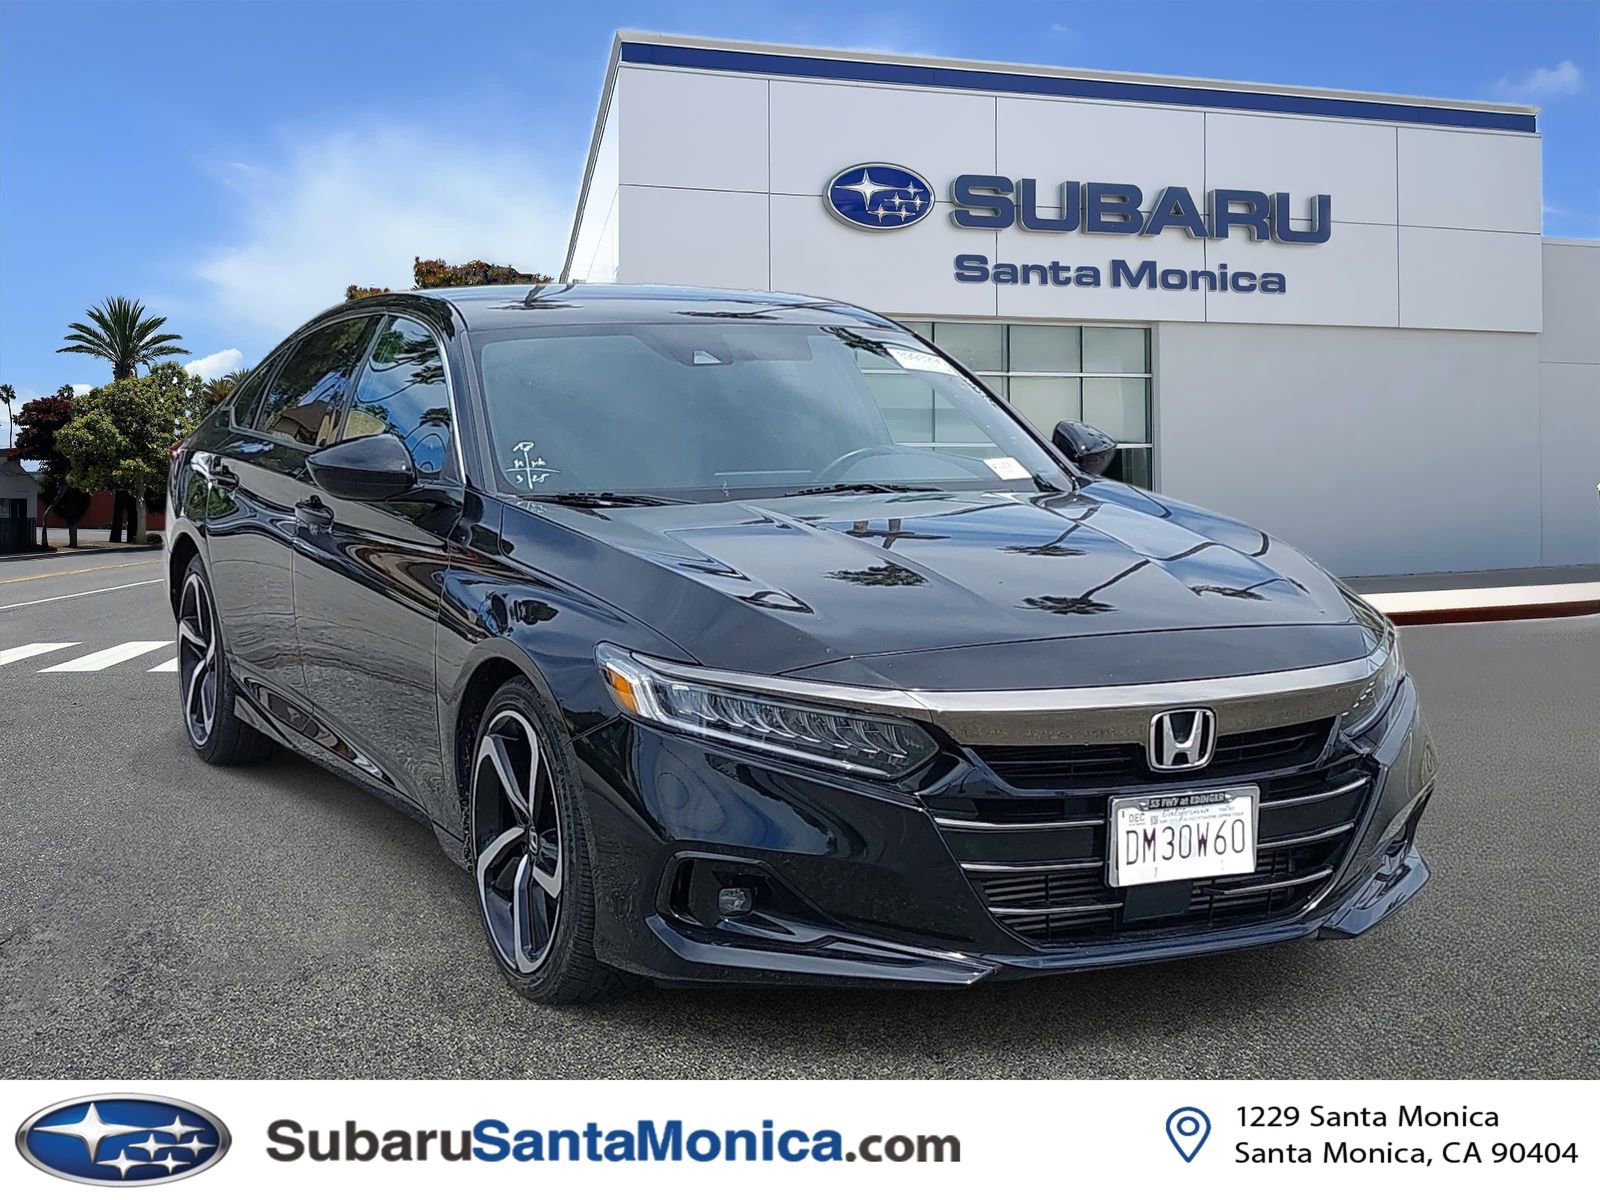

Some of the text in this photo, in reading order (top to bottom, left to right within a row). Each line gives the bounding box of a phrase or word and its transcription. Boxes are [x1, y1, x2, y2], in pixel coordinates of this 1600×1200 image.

[950, 174, 1331, 244] SUBARU
[954, 254, 1287, 294] Santa Monica
[1129, 813, 1145, 822] DEC
[1126, 819, 1245, 866] DM30W60
